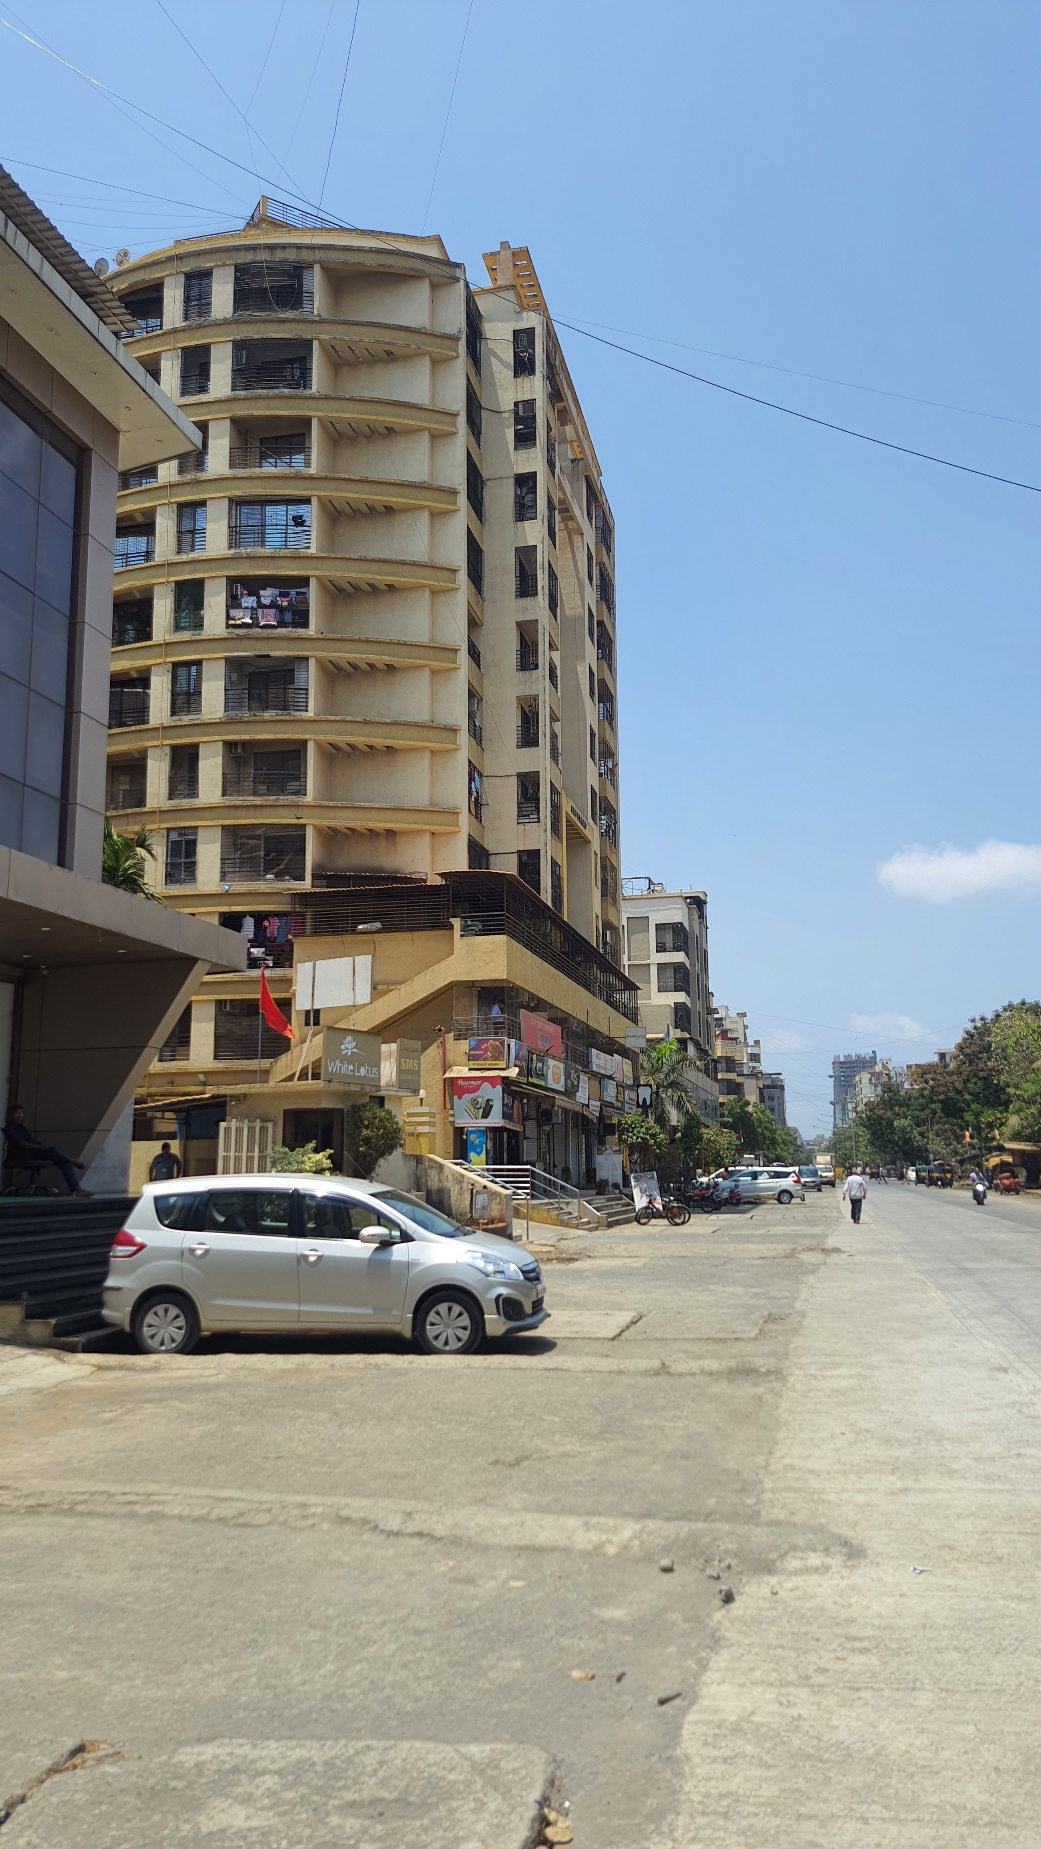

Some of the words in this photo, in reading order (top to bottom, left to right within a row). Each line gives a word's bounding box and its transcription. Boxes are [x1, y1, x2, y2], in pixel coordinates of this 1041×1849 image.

[327, 1058, 354, 1075] White
[355, 1062, 379, 1078] Lotus
[400, 1058, 419, 1071] SMS
